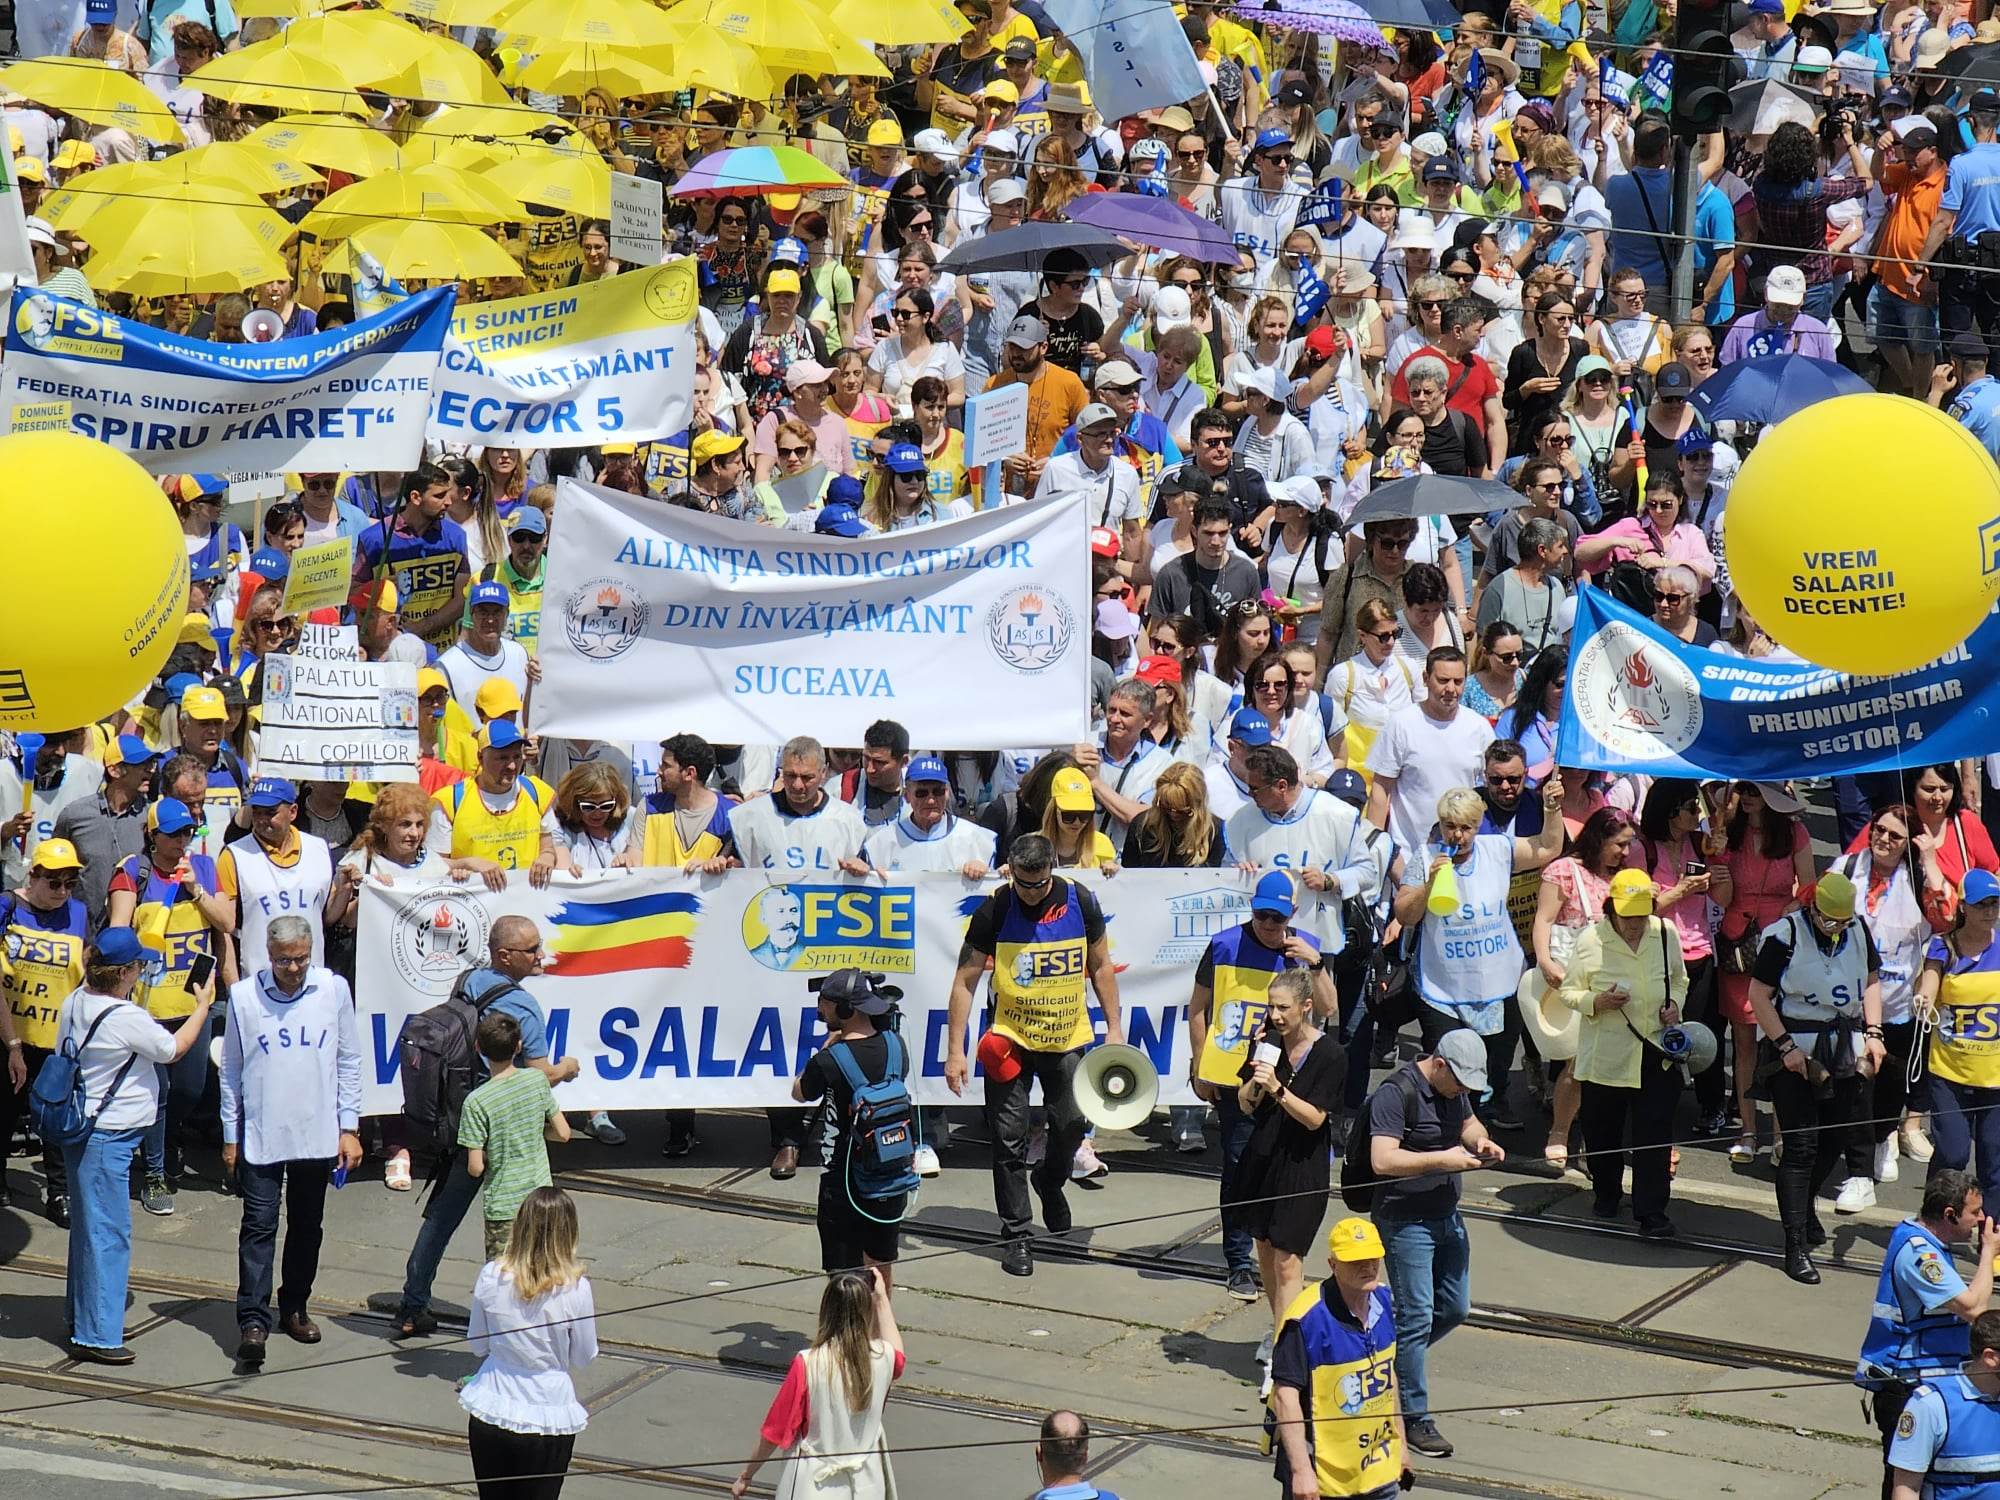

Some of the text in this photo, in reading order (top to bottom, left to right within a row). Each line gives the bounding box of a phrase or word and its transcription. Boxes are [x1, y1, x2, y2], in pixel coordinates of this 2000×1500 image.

[54, 302, 125, 341] FSE
[474, 298, 578, 331] SUNTEM
[52, 337, 121, 357] Spiru Haret
[463, 322, 564, 355] TERNICI!
[218, 353, 309, 370] SUNTEM
[16, 376, 429, 415] FEDERAȚIA SINDICATELOR DIN EDUCAȚIE
[20, 405, 64, 418] DOMNULE
[596, 396, 624, 432] 5
[71, 412, 210, 451] SPIRU
[296, 555, 320, 569] VREM
[613, 536, 1035, 583] ALIANȚA SINDICATELOR
[1803, 549, 1877, 570] VREM
[303, 567, 338, 585] DECENTE
[412, 562, 455, 589] FSE
[1792, 571, 1895, 593] SALARII
[664, 595, 974, 638] DIN ÎNVĂȚĂMÂNT
[1784, 592, 1906, 615] DECENTE!
[129, 626, 158, 659] DOAR
[295, 666, 379, 687] PALATUL
[734, 665, 896, 698] SUCEAVA
[1729, 686, 1779, 702] DIN
[1748, 677, 1963, 733] PREUNIVERSITAR
[282, 702, 379, 724] NATIONAL
[281, 744, 409, 761] AL COPIILOR
[1802, 721, 1924, 759] SECTOR 4
[803, 891, 913, 941] FSE
[20, 937, 70, 966] FSE
[166, 932, 206, 969] FS
[803, 948, 912, 970] Spiru Haret
[1034, 948, 1083, 977] FSE
[2, 974, 50, 999] S.I.P.
[166, 972, 188, 986] Spi
[6, 1000, 59, 1027] LAȚI
[1015, 993, 1078, 1006] Sindicatul
[1955, 1006, 2000, 1039] FS
[257, 1025, 328, 1055] FSLI
[881, 1130, 906, 1145] LiveU
[1361, 1361, 1394, 1399] FS
